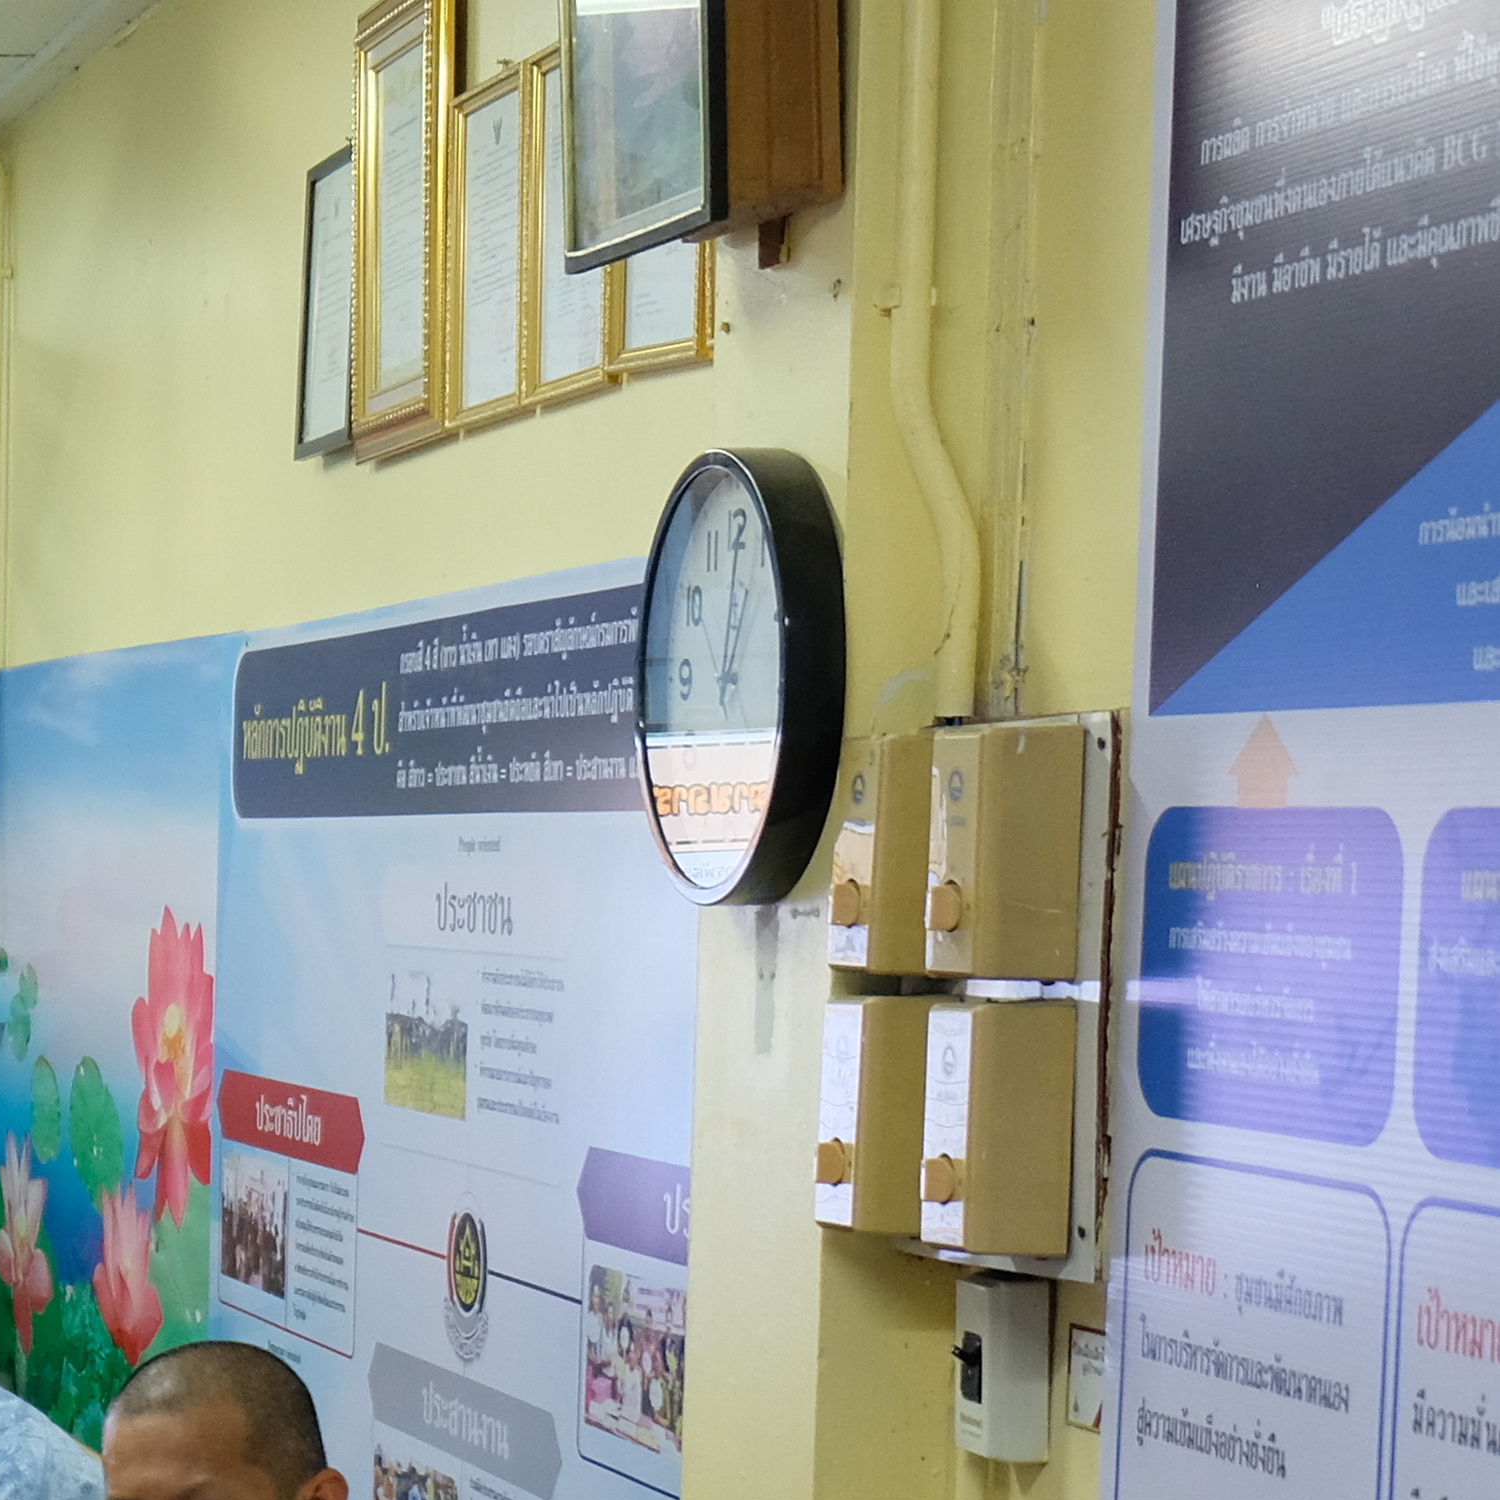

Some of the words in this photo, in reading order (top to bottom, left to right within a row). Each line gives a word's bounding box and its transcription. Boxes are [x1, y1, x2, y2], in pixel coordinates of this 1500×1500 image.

[706, 530, 718, 573] 11
[728, 508, 747, 550] 12
[686, 584, 702, 627] 10
[678, 658, 693, 701] 9
[243, 697, 347, 775] หลักการปฏิบัติงาน
[352, 689, 364, 755] 4
[372, 681, 390, 755] ป.
[435, 882, 513, 936] ประชาชน
[1144, 1228, 1216, 1296] เป้าหมาย
[1417, 1286, 1500, 1363] เป้าหมา
[422, 1381, 510, 1461] ประสานงาน
